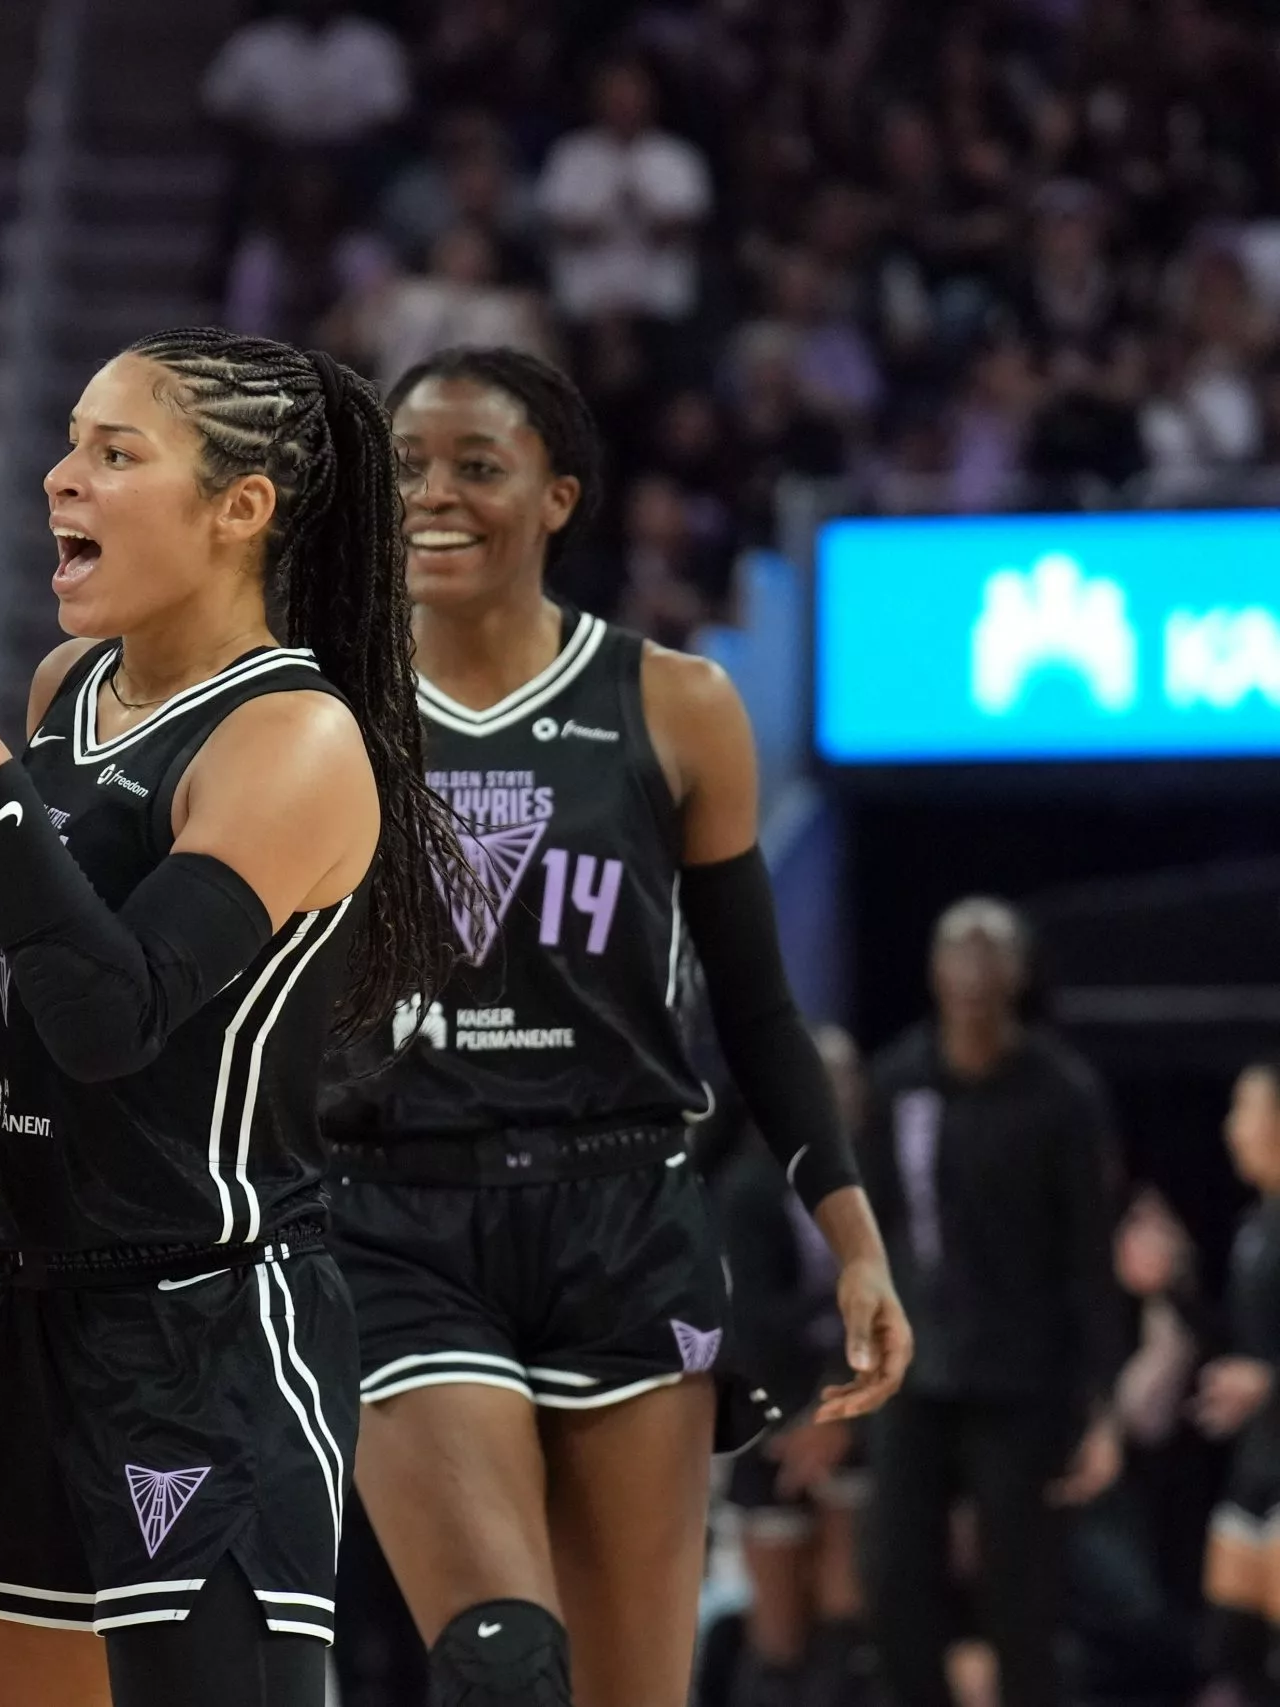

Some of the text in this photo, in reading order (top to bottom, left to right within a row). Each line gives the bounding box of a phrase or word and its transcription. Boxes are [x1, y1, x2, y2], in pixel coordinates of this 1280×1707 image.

[105, 769, 149, 797] freedom
[485, 770, 534, 788] STATE
[538, 847, 624, 955] 14
[456, 1007, 515, 1028] KAISER
[456, 1028, 575, 1051] PERMANENTE
